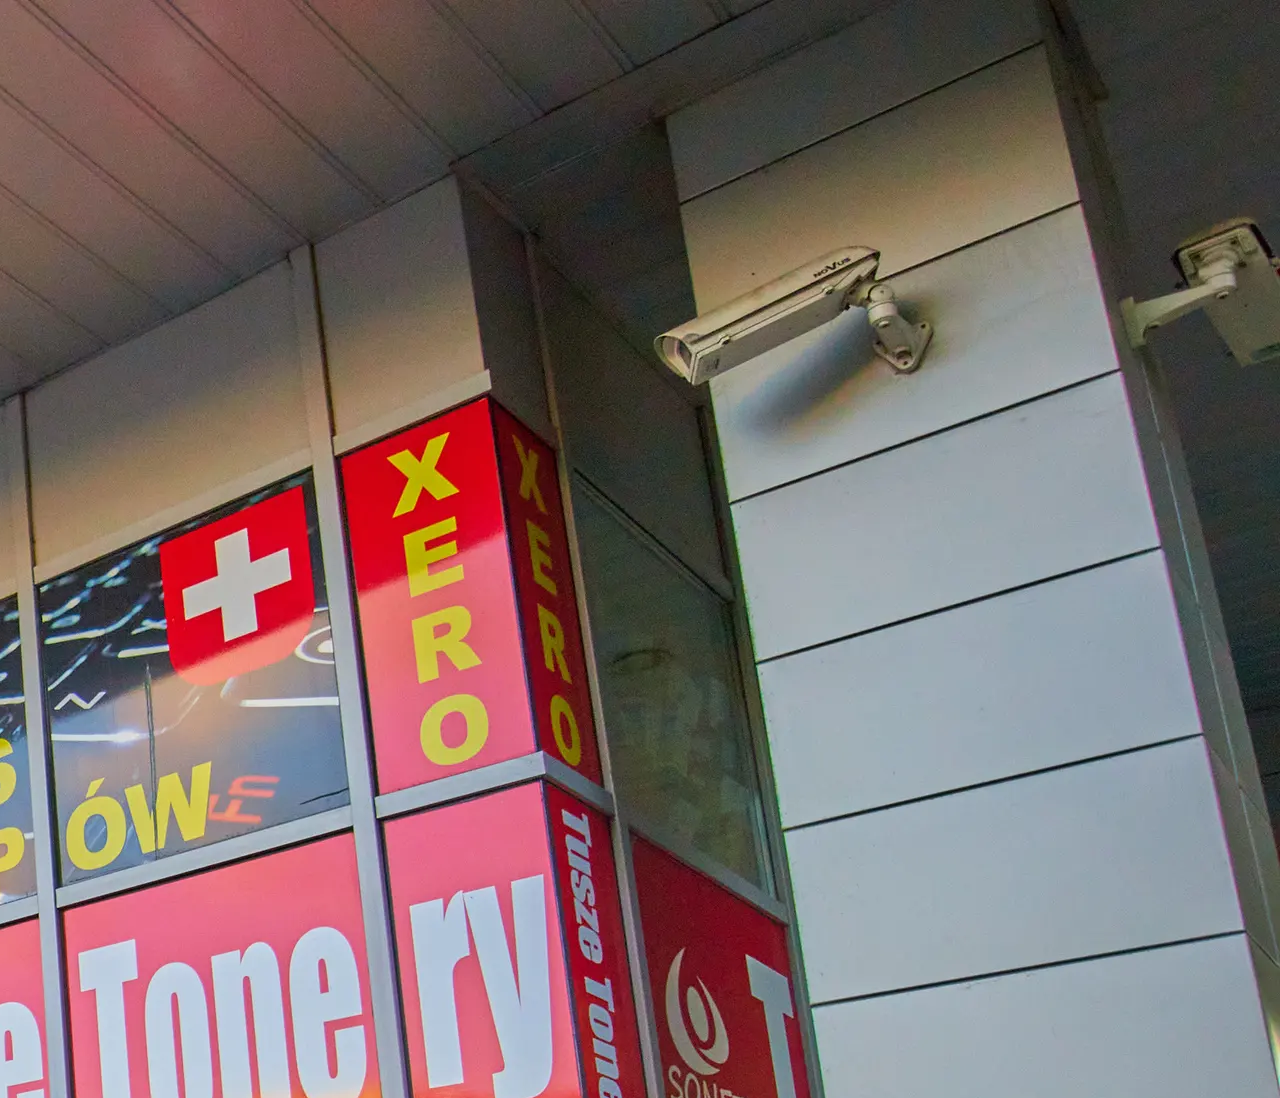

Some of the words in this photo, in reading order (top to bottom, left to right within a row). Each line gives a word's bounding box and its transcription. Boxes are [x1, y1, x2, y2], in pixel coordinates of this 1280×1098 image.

[385, 432, 490, 768] XERO
[512, 432, 581, 768] XERO
[560, 807, 606, 965] Tusze
